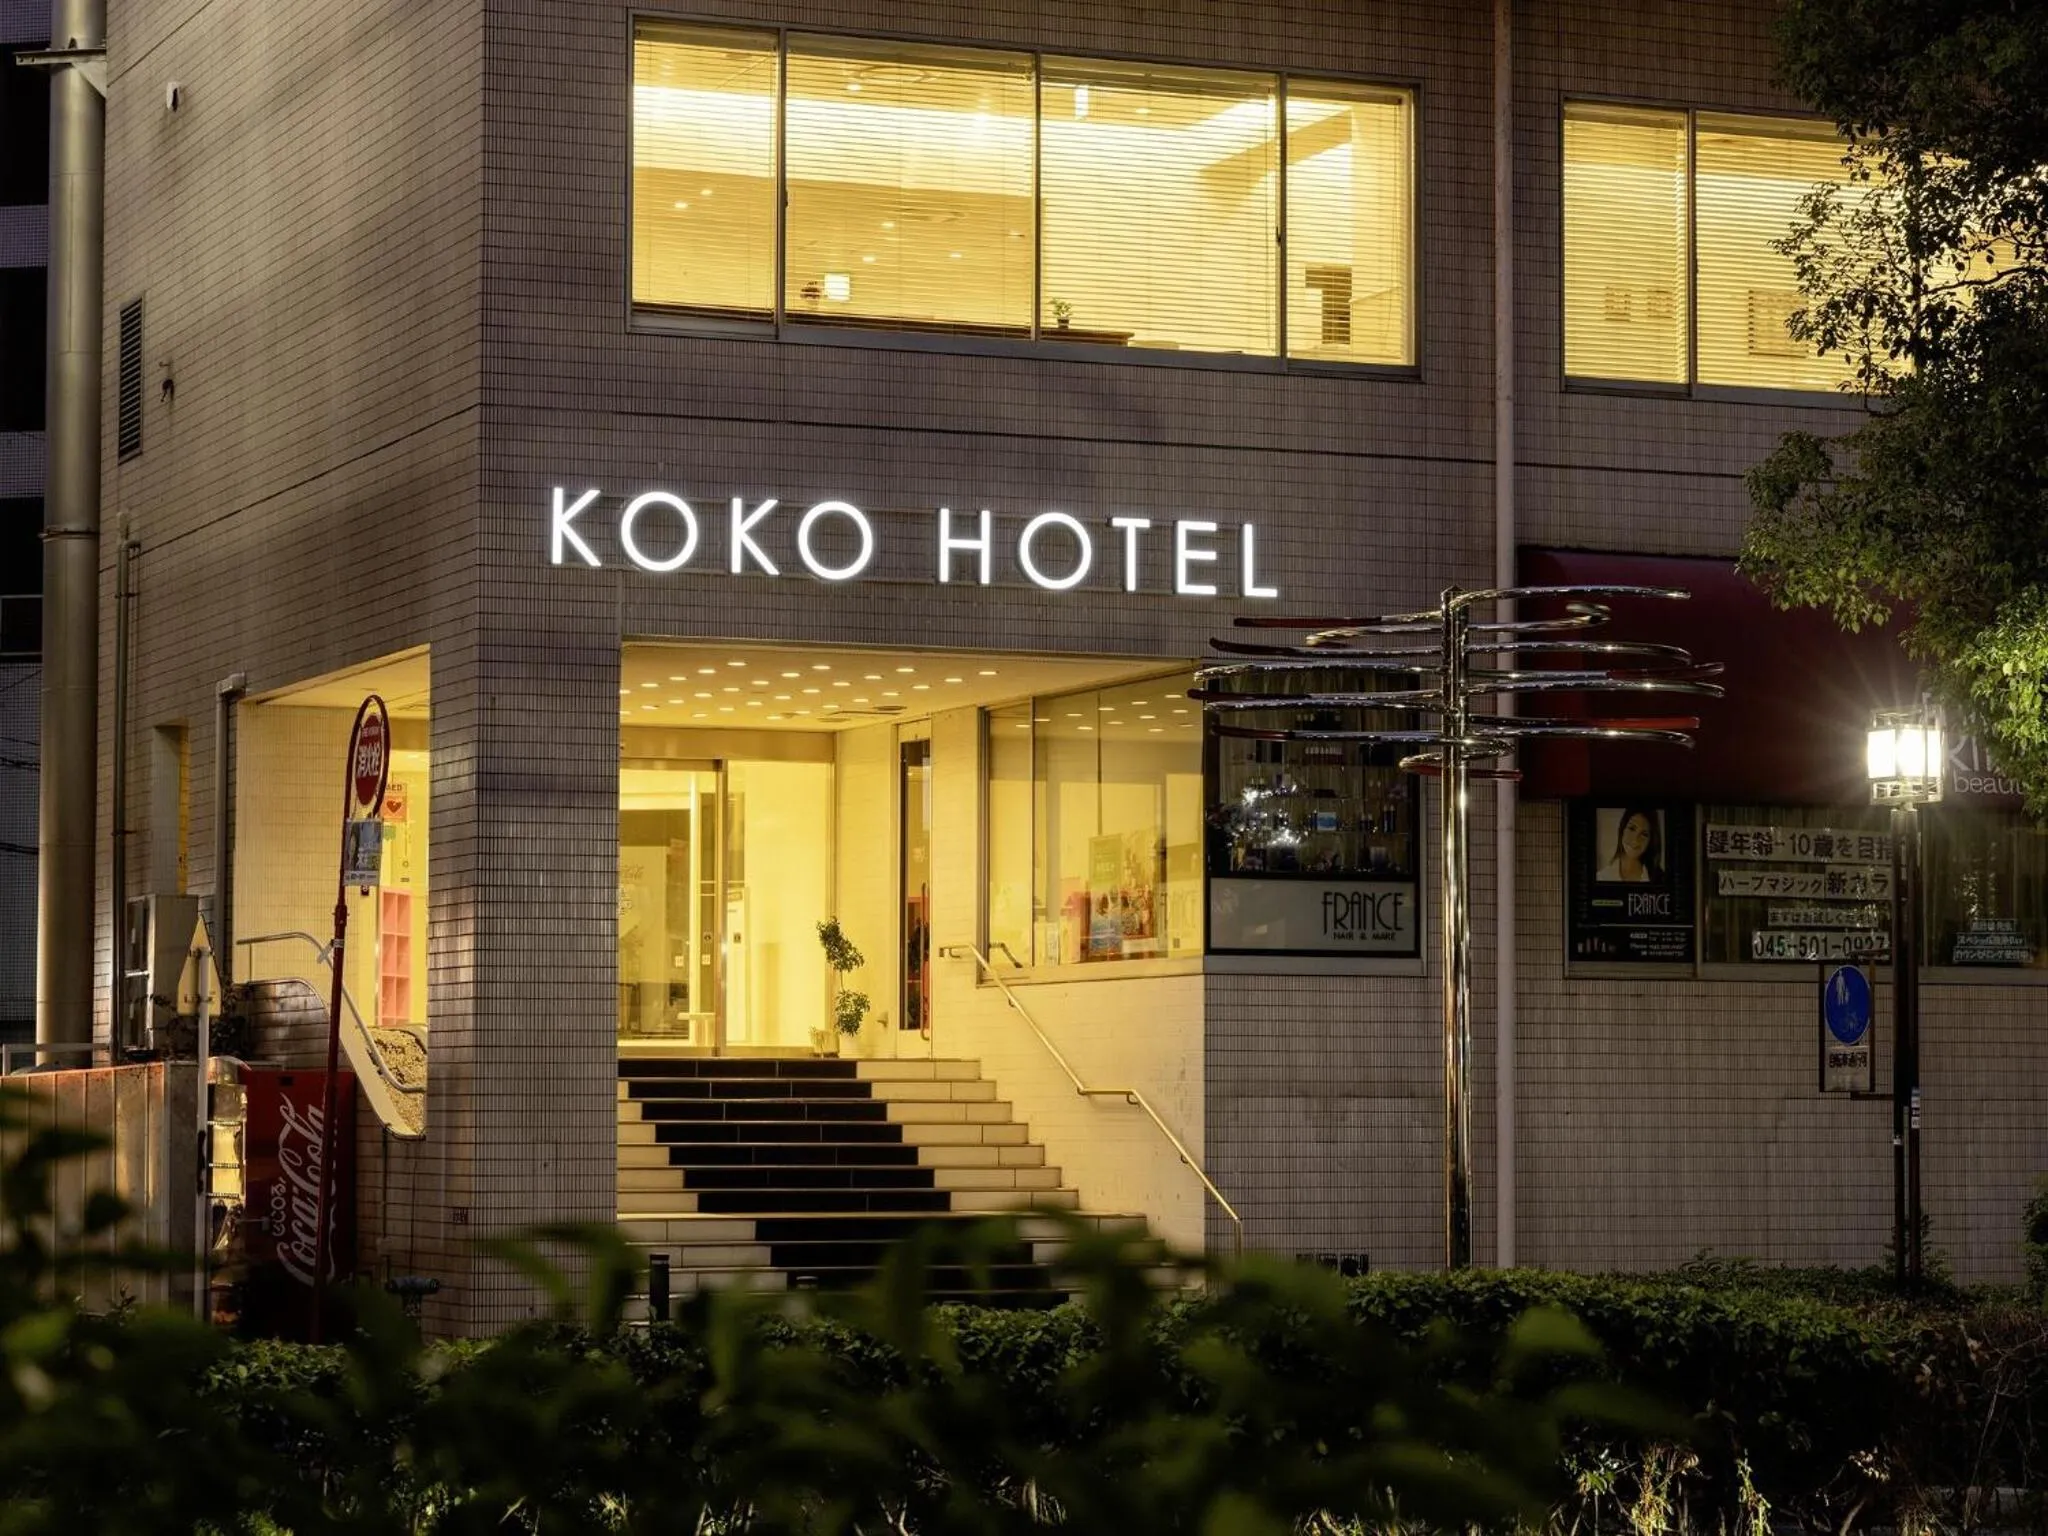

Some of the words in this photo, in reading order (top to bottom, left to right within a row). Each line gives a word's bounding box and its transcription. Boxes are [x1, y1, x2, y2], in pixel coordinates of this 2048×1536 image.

[551, 487, 873, 580] KOKO
[939, 508, 1278, 598] HOTEL
[357, 741, 380, 777] 消火栓
[1953, 769, 2024, 795] beaut
[1321, 891, 1404, 936] FRANCE
[1628, 892, 1671, 917] FRANCE
[276, 1092, 335, 1287] Coca-Cola
